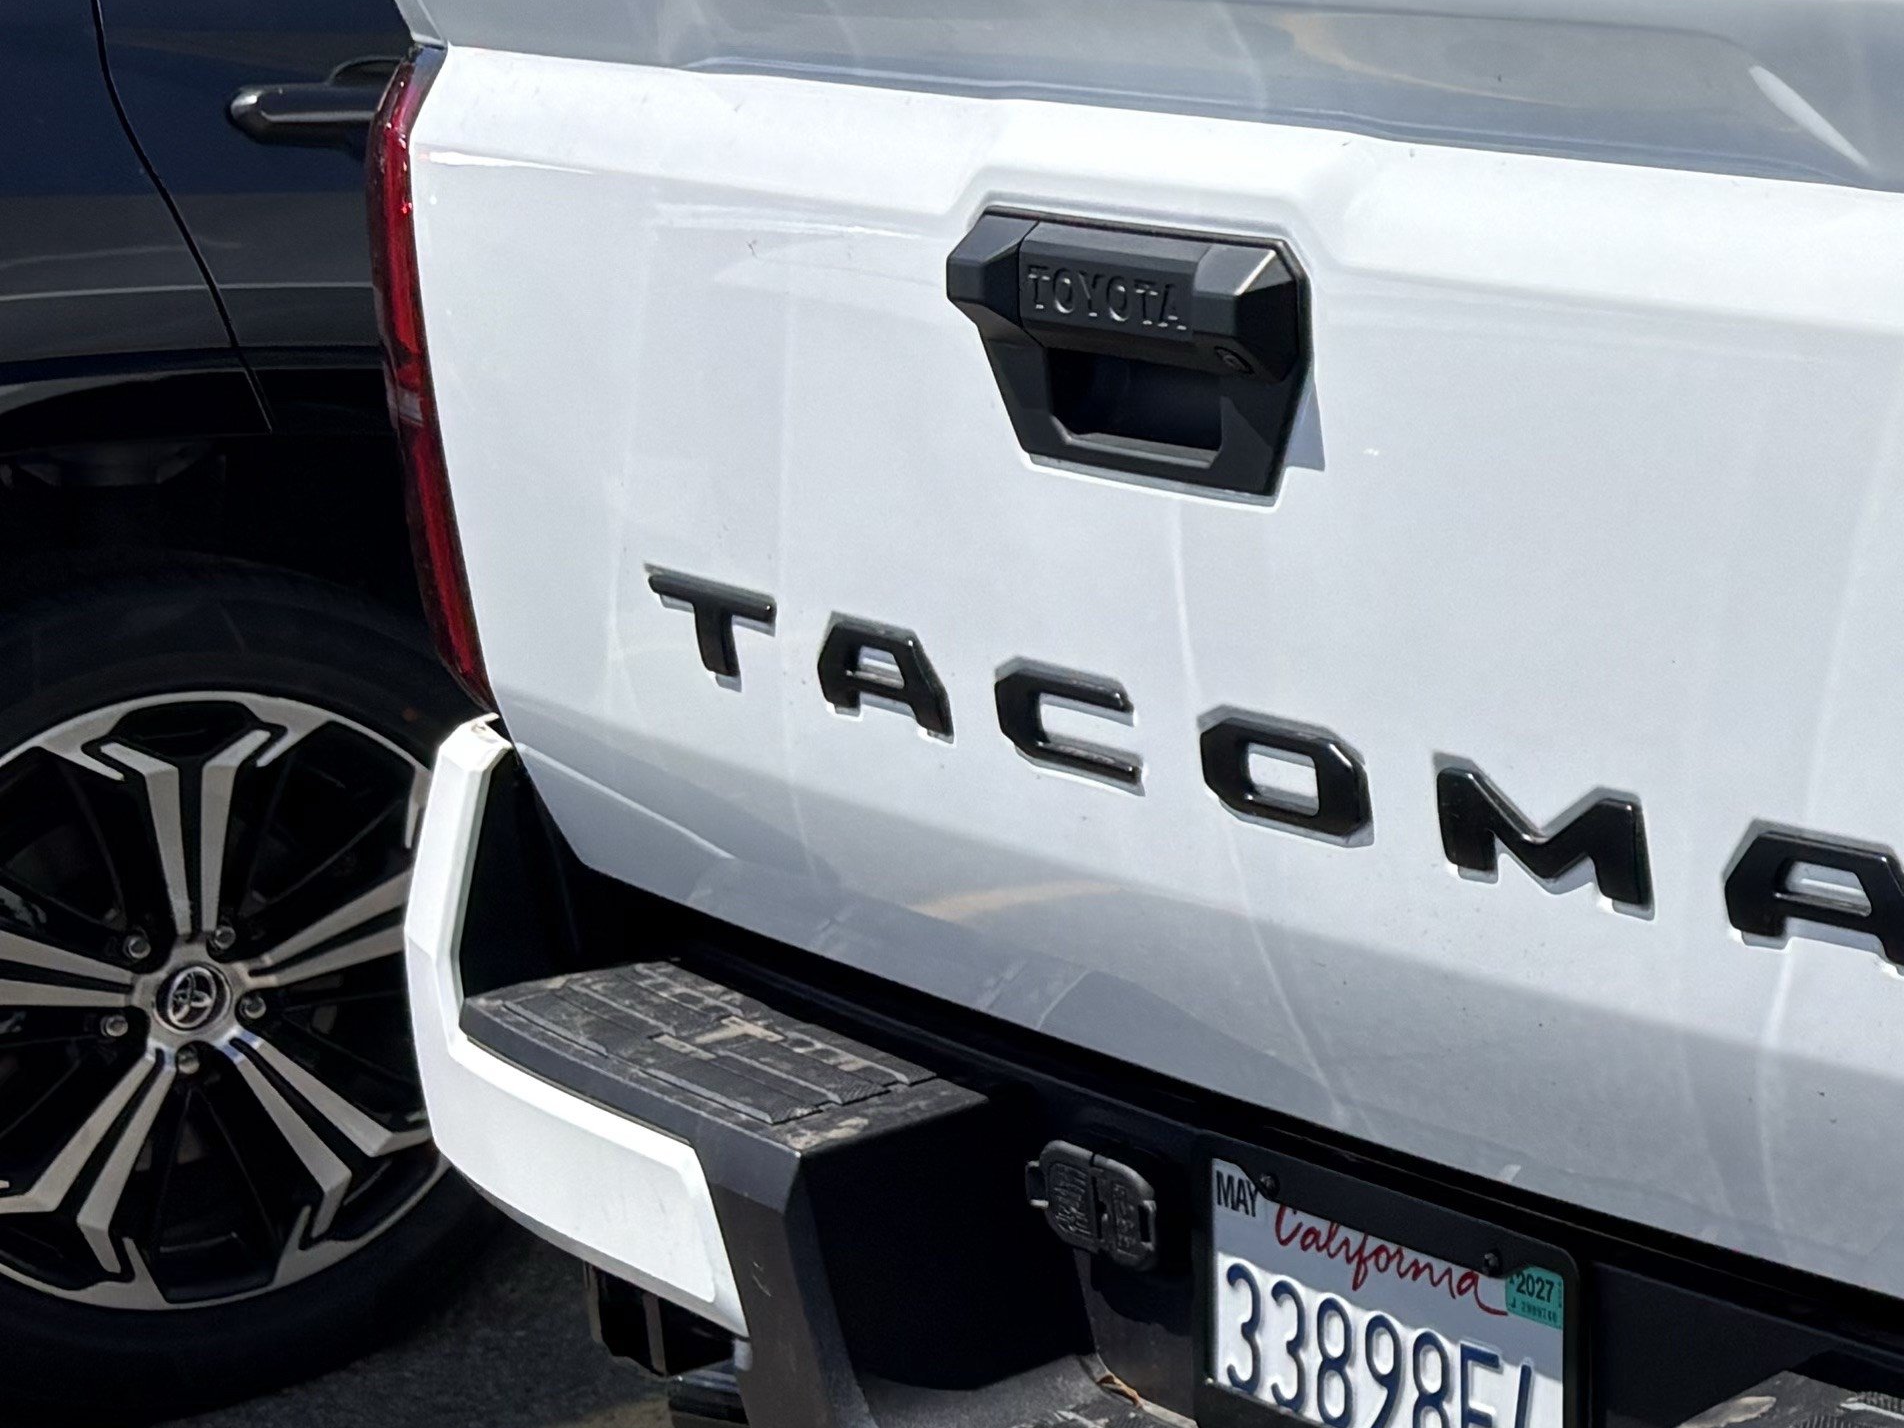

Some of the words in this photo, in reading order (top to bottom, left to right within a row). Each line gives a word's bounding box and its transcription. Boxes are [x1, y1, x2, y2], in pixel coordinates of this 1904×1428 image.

[1027, 264, 1188, 330] TOYOTA
[1216, 1170, 1259, 1217] MAY
[1275, 1204, 1508, 1319] California
[1516, 1271, 1555, 1303] 2027
